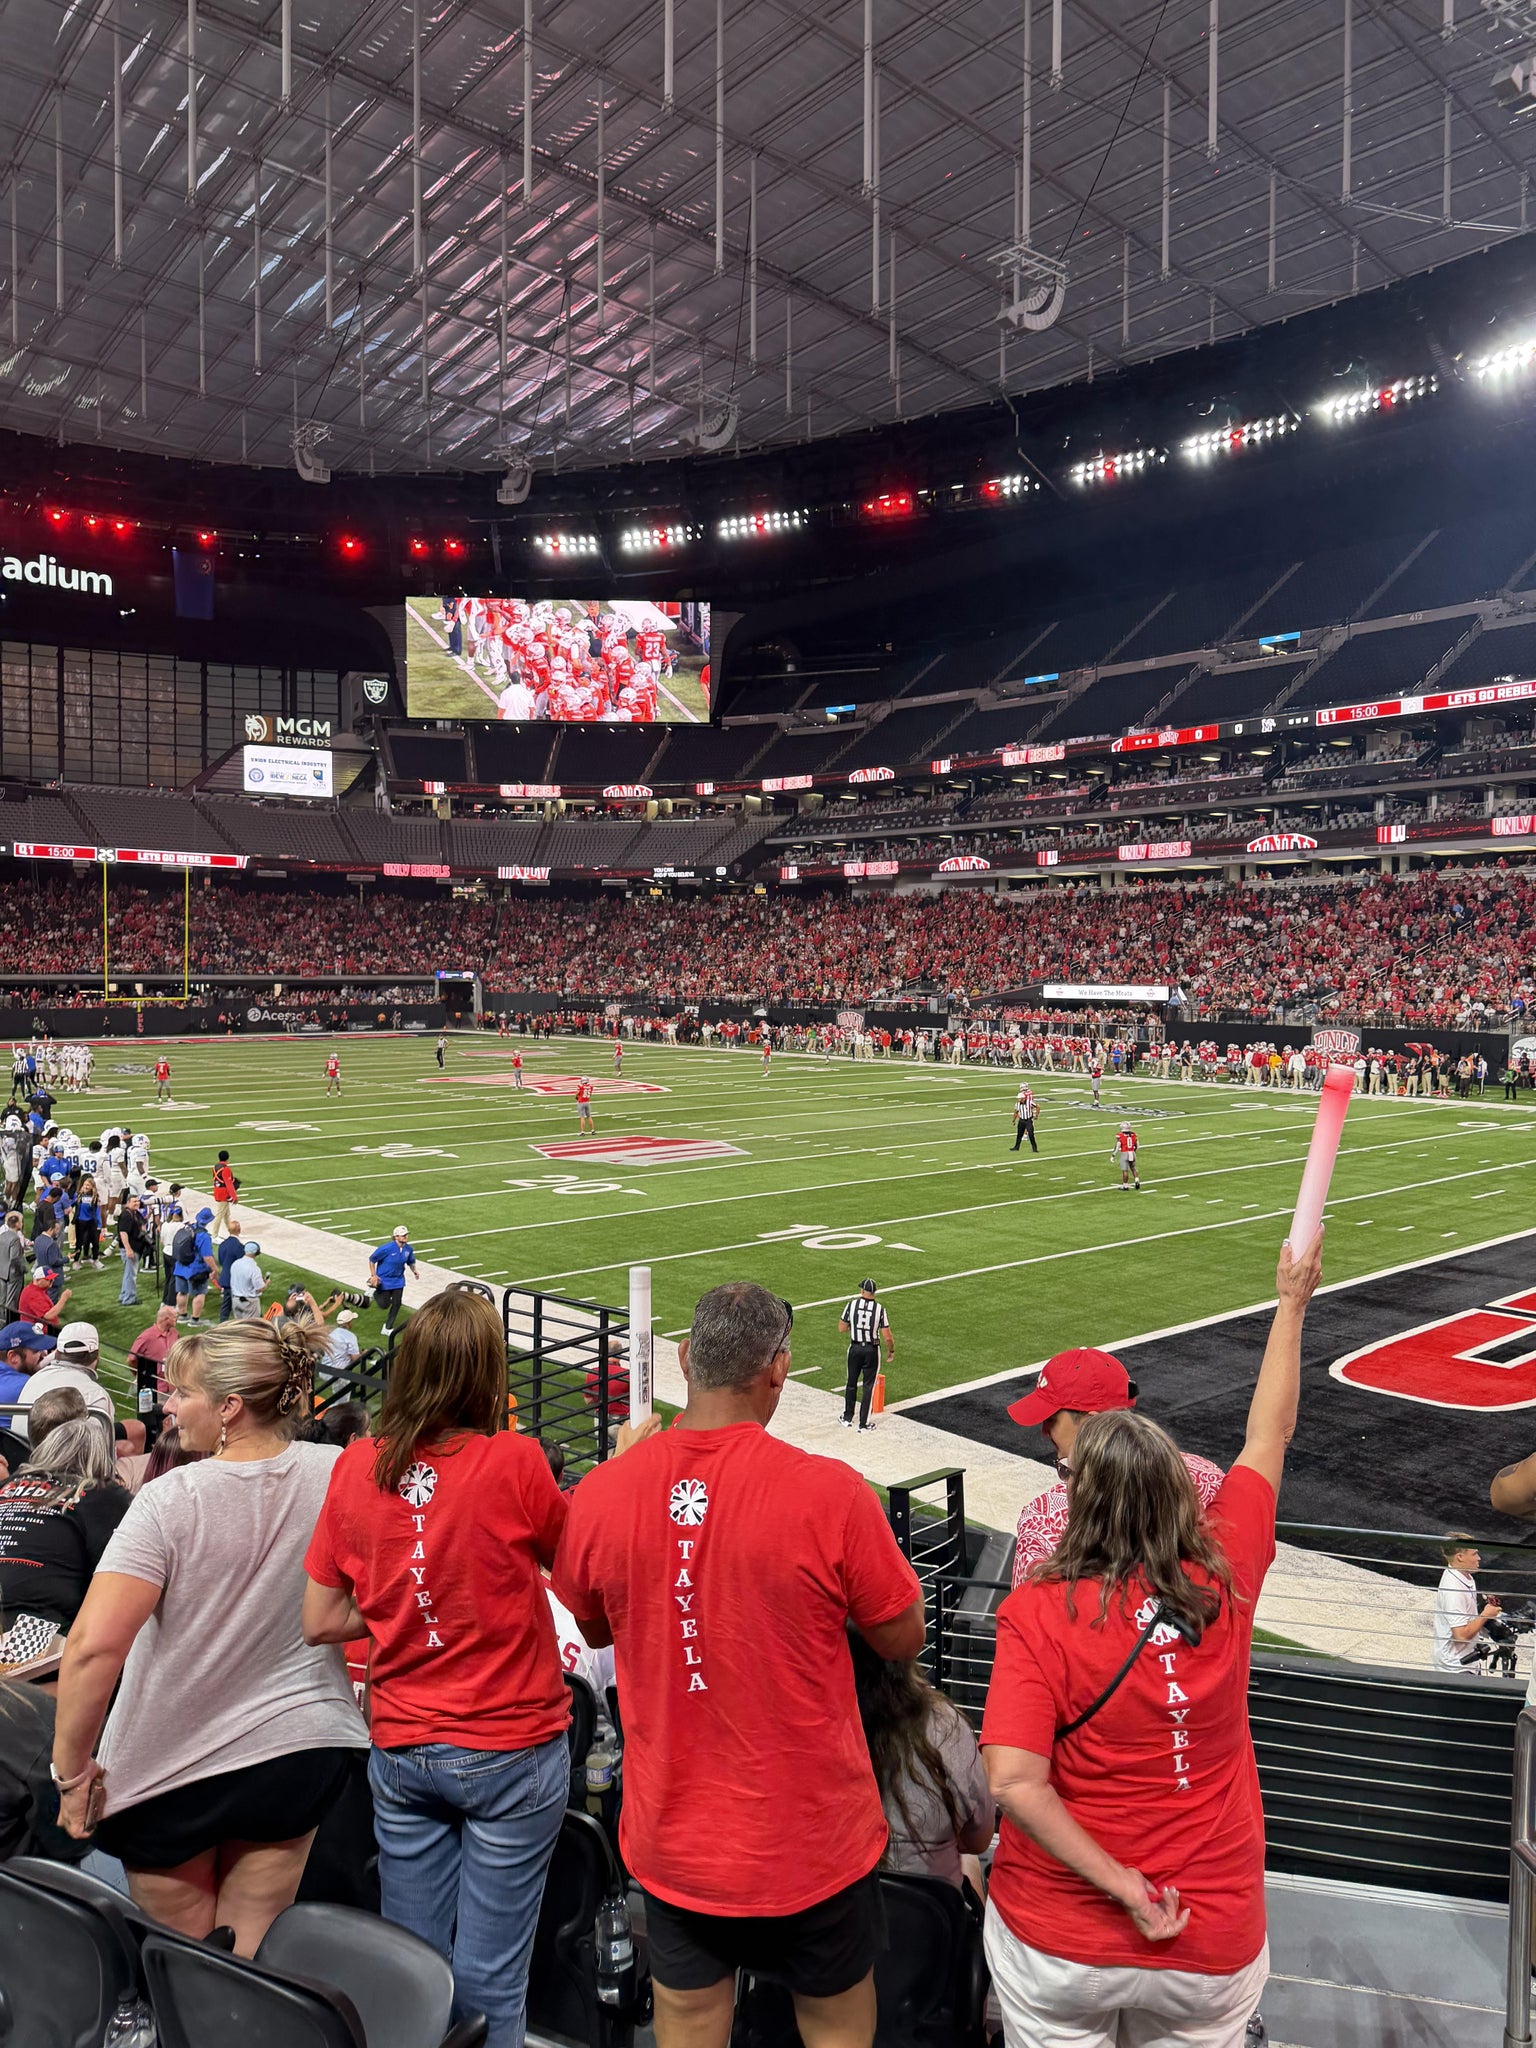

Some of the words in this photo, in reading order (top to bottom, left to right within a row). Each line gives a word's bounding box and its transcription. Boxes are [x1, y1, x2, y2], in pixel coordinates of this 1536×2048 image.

[2, 553, 113, 596] adium
[1448, 692, 1477, 706] LETS
[1479, 690, 1495, 701] GO
[1497, 683, 1536, 699] REBEL
[1320, 710, 1336, 723] Q1
[1350, 706, 1379, 719] 15:00
[276, 716, 331, 737] MGM
[276, 735, 332, 748] REWARDS
[1027, 746, 1065, 764] REBELS
[1491, 815, 1532, 836] UNLV
[18, 845, 34, 855] Q1
[47, 847, 75, 858] 15:00
[137, 852, 161, 863] LETS
[176, 854, 211, 865] REBELS
[1118, 843, 1148, 861] UNLV
[1148, 841, 1192, 858] REBELS
[411, 864, 451, 878] REBELS
[684, 1006, 700, 1014] PTS
[1314, 1029, 1360, 1053] UNLV
[84, 1159, 98, 1174] 93
[501, 1174, 623, 1195] 20
[756, 1224, 883, 1250] 10
[856, 1309, 871, 1330] H
[409, 1514, 445, 1647] TAYELA
[674, 1540, 708, 1692] TAYELA
[1159, 1653, 1192, 1793] TAYELA
